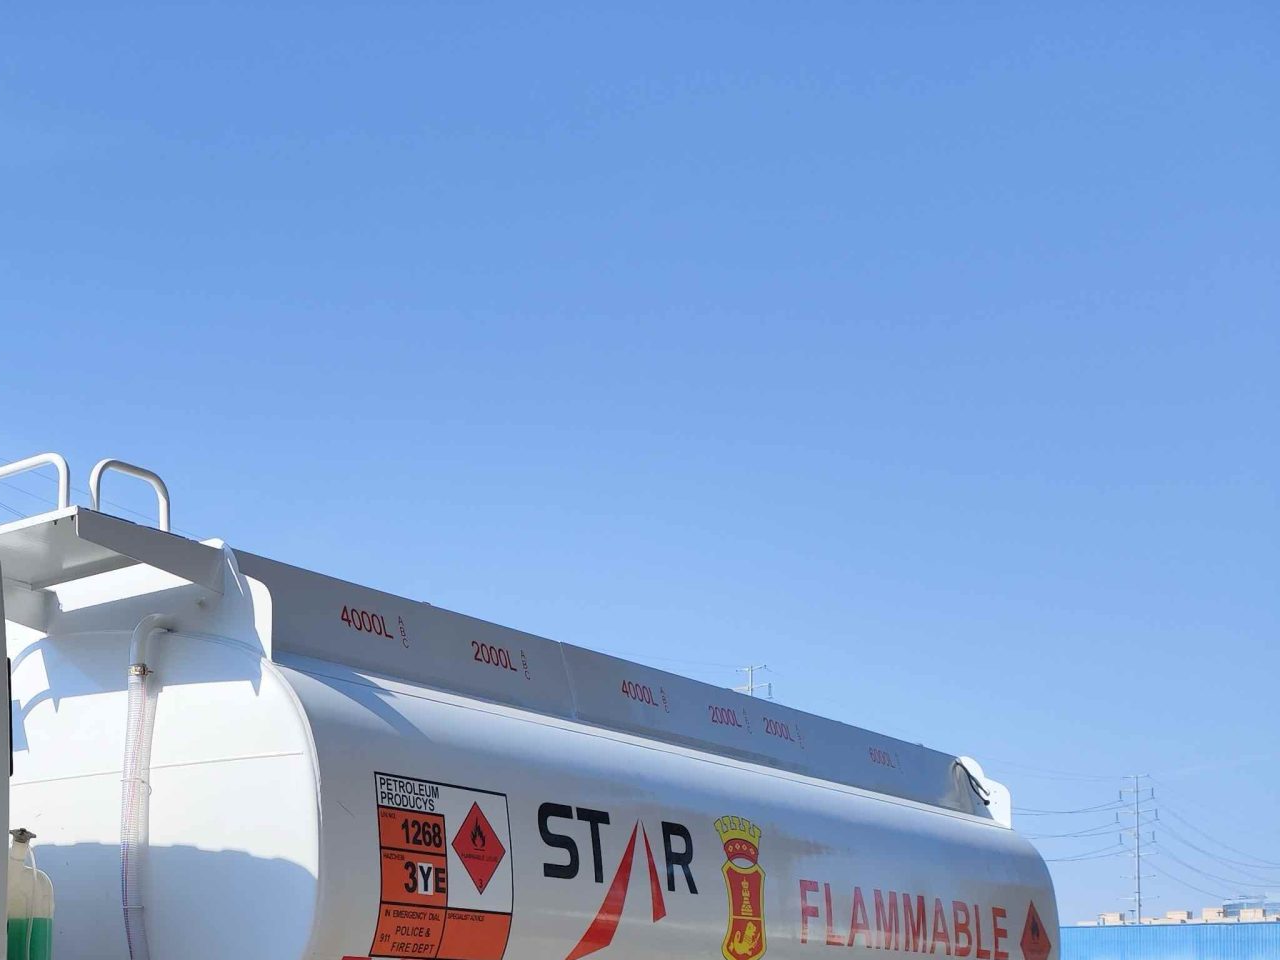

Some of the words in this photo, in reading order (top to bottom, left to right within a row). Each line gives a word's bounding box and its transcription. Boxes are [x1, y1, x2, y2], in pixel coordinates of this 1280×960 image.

[340, 604, 394, 639] 4000L
[471, 640, 518, 672] 2000L
[621, 679, 659, 707] 4000L
[707, 705, 743, 728] 2000L
[763, 716, 796, 742] 2000L
[379, 776, 440, 800] PETROLEUM
[380, 791, 435, 812] PRODUCYS
[401, 818, 443, 848] 1268
[404, 861, 446, 894] 3YE
[384, 909, 391, 917] IN
[392, 909, 427, 920] EMERGENCY
[428, 912, 441, 922] DIAL
[379, 933, 391, 943] 911
[395, 925, 424, 937] POLICE
[424, 927, 431, 938] &
[390, 941, 411, 953] FIRE
[412, 943, 436, 954] DEPT
